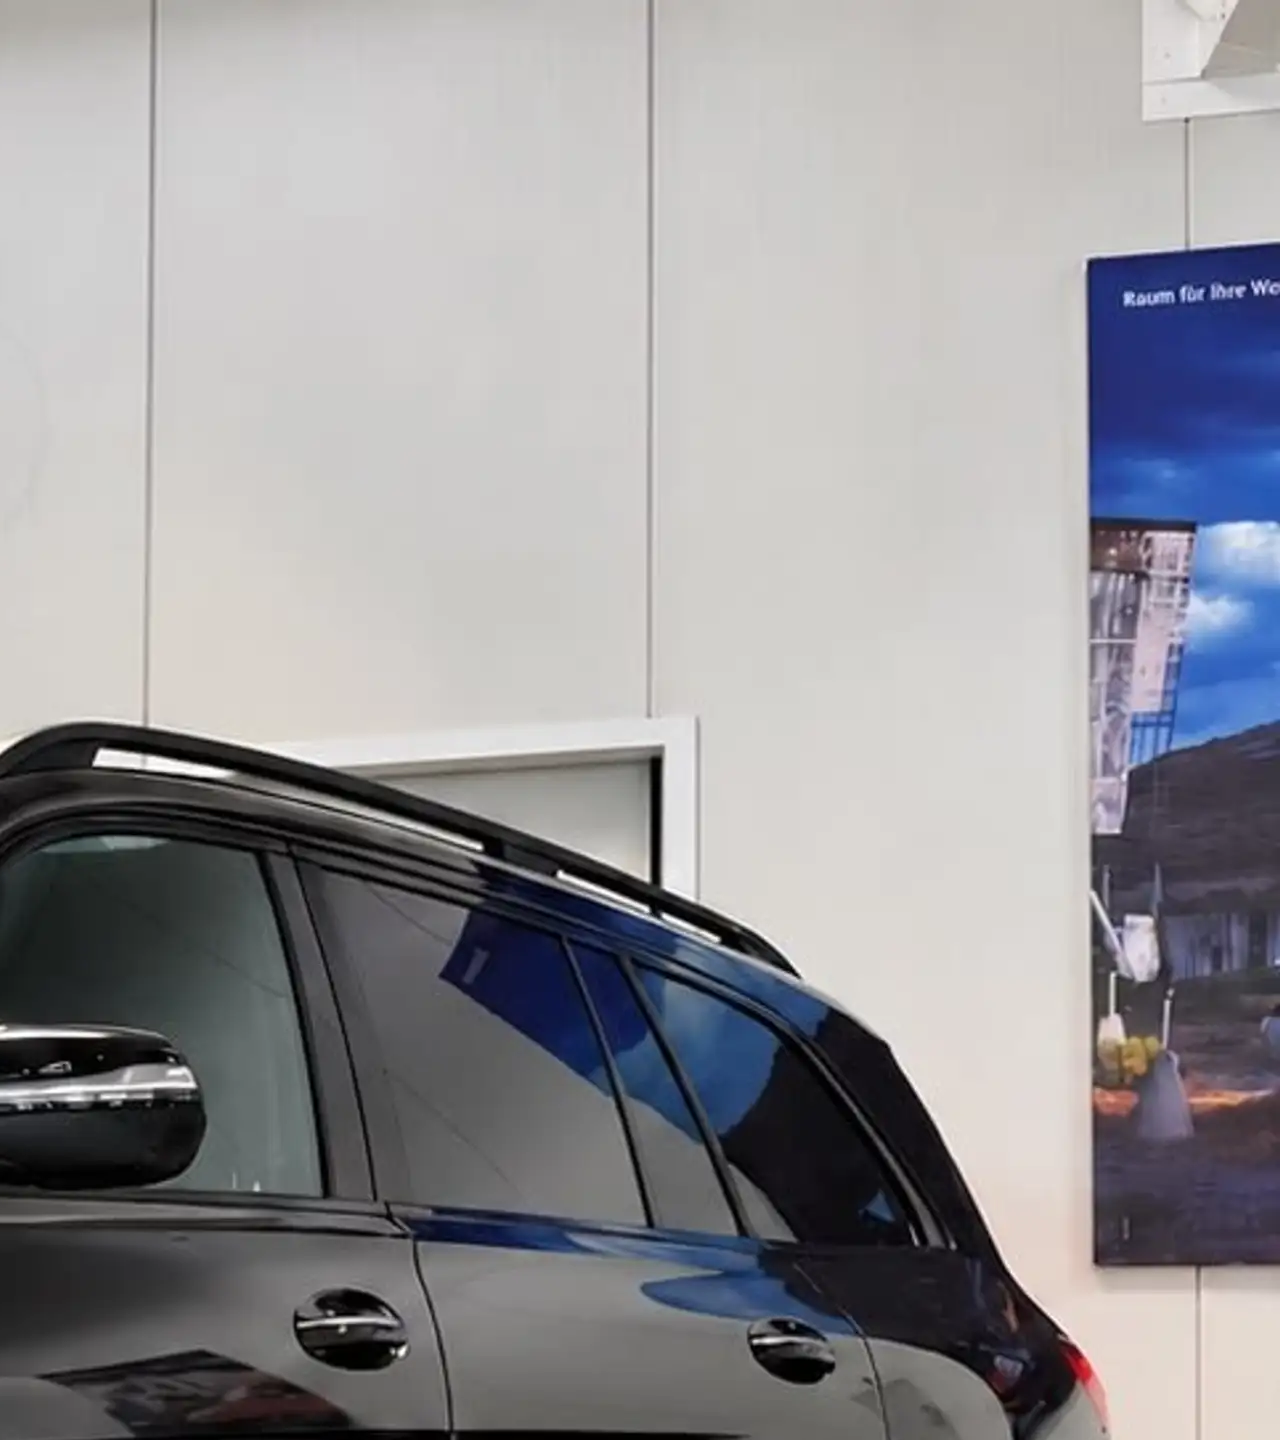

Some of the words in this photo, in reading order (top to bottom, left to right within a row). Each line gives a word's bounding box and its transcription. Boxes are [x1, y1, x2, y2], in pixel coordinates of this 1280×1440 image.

[1123, 290, 1176, 307] Raum
[1179, 284, 1206, 303] für
[1210, 282, 1247, 300] Ihre
